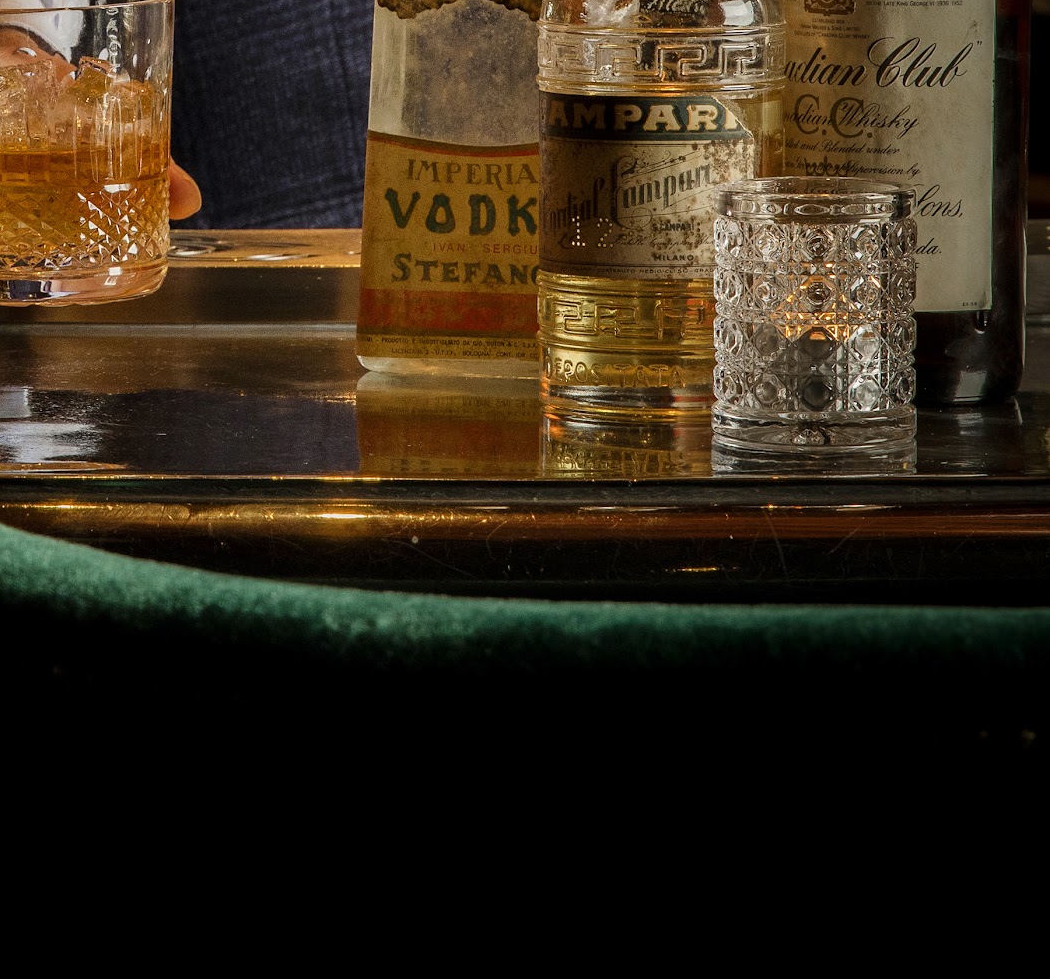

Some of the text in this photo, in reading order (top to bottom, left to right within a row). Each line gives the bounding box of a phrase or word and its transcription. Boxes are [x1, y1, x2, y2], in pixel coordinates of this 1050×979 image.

[838, 101, 920, 139] Whisky
[820, 140, 864, 153] Blended
[866, 144, 900, 154] under
[406, 158, 538, 191] IMPERIA
[905, 162, 921, 179] by
[384, 186, 538, 238] VODK
[433, 243, 538, 255] IVAN SERGIU
[653, 254, 695, 262] MILANO
[462, 350, 490, 358] BOLOGNA
